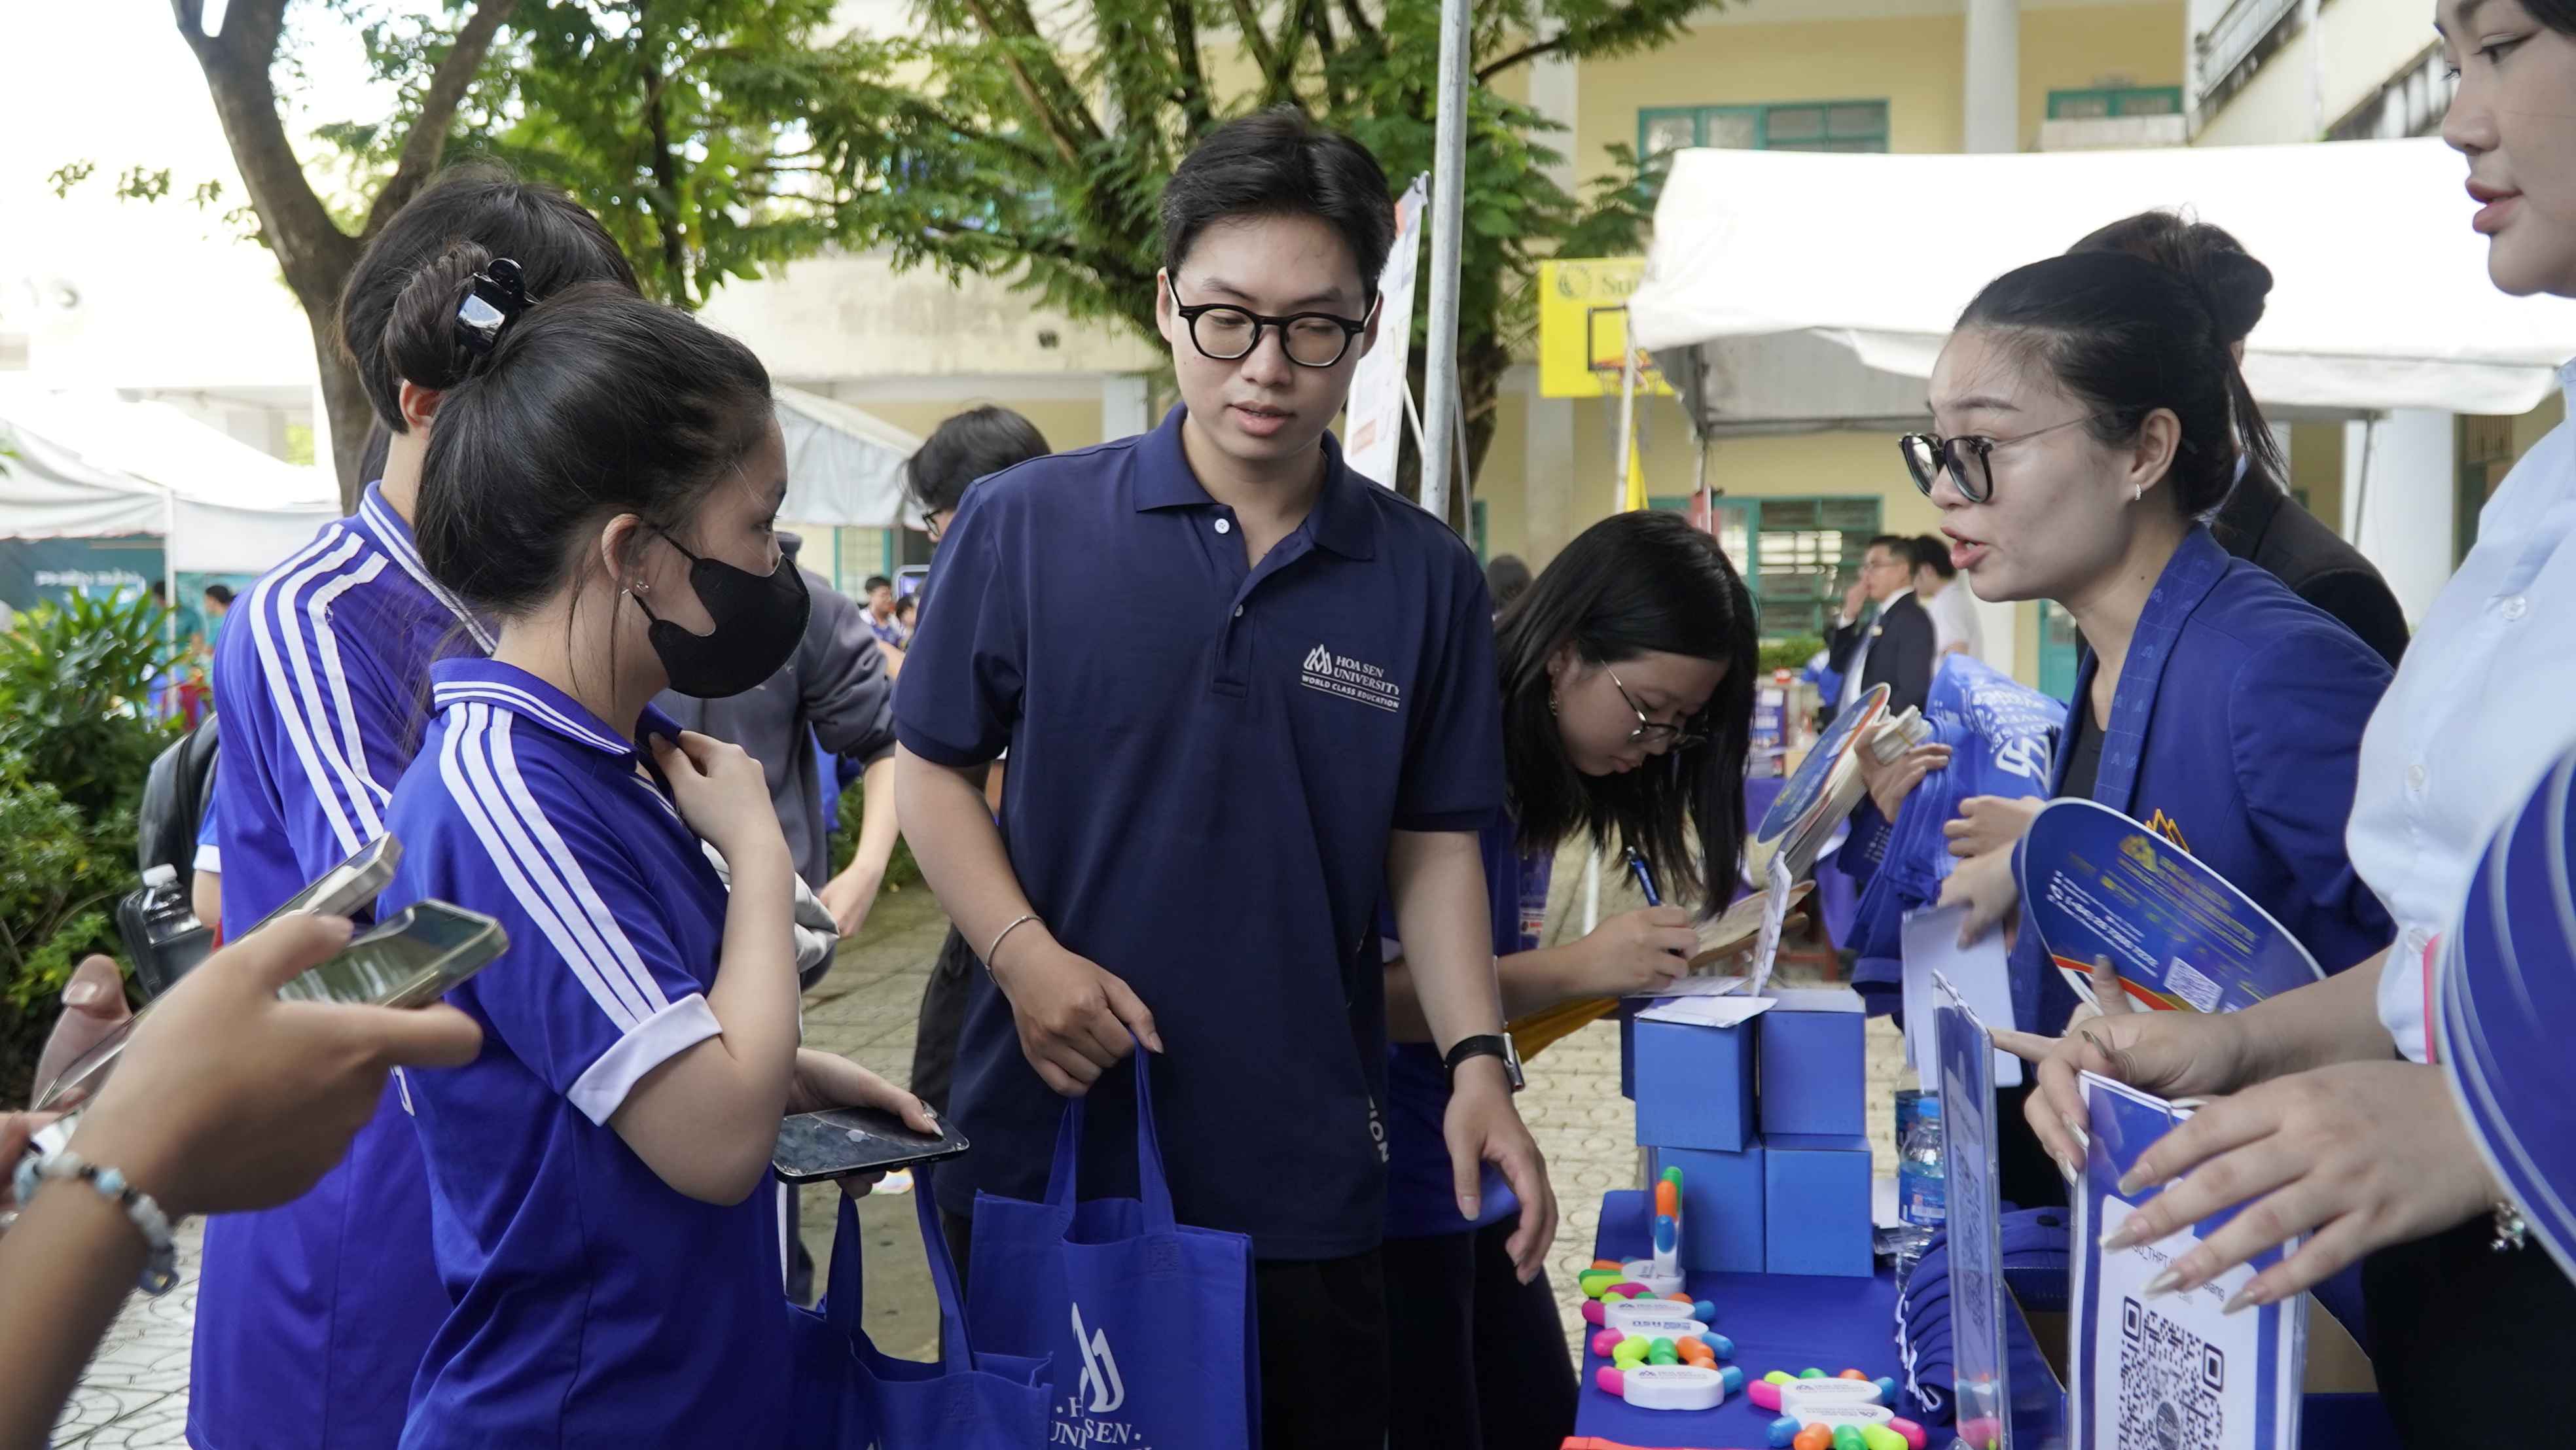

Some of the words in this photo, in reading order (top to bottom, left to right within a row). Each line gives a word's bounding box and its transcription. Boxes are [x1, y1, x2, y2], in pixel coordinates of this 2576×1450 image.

[1336, 655, 1361, 672] HOA
[1362, 663, 1384, 677] SEN
[1302, 675, 1331, 688] WORLD
[1332, 683, 1356, 696] CLASS
[1357, 691, 1399, 709] EDUCATION
[1333, 667, 1400, 695] UNIVERSITY
[1368, 1094, 1389, 1163] ION
[2130, 1244, 2168, 1267] SU_THPT
[1084, 1417, 1132, 1445] SEN
